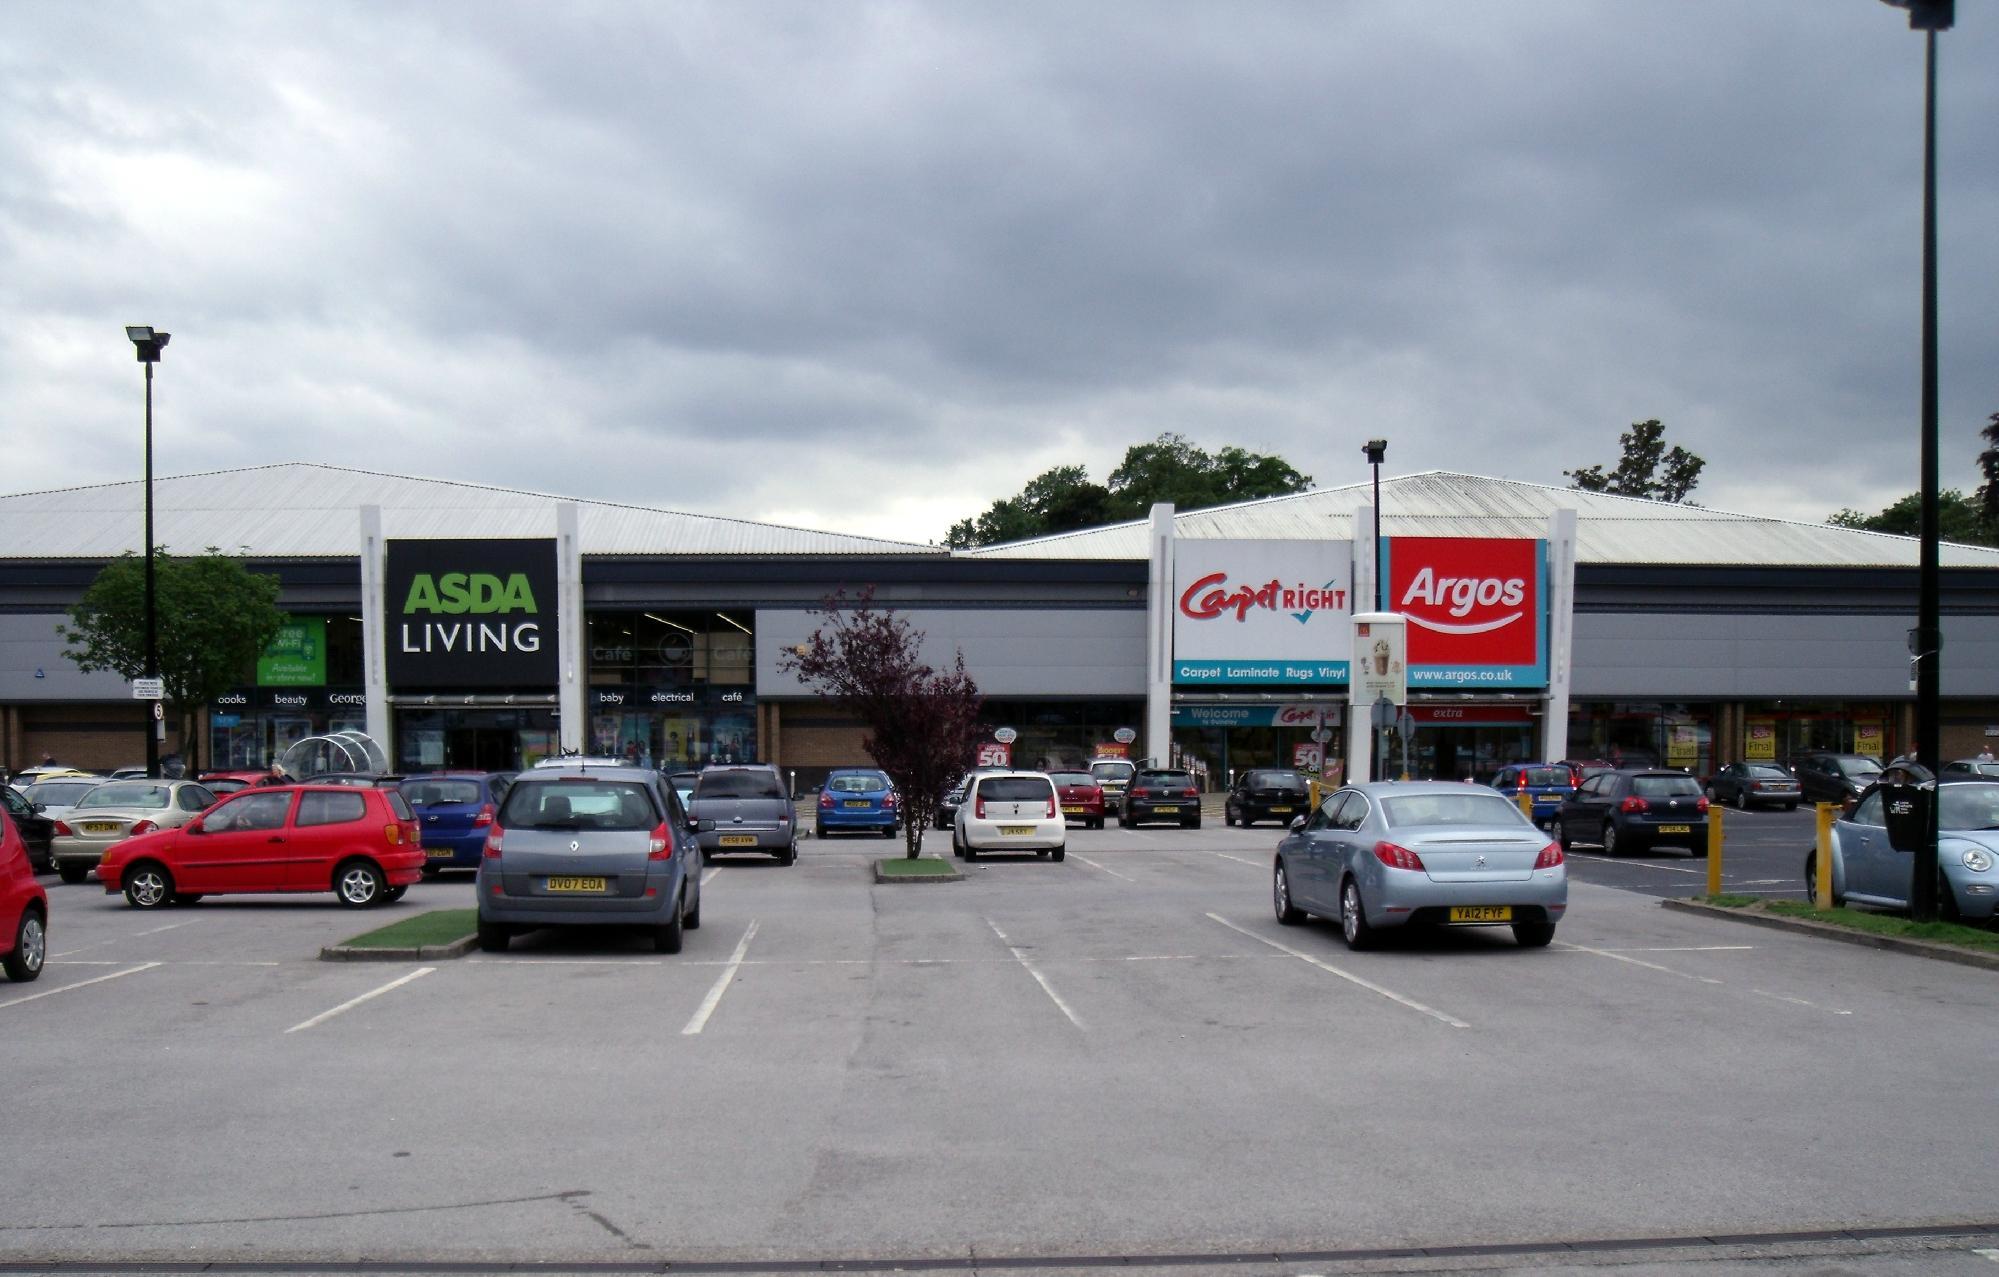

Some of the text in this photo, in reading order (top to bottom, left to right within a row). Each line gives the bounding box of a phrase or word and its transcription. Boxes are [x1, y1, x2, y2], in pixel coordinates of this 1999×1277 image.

[403, 573, 538, 614] ASDA
[1402, 568, 1525, 617] Argos
[403, 623, 540, 653] LIVING
[592, 647, 633, 661] Café
[1181, 667, 1345, 680] Carpet Laminate Rugs Vinyl
[1413, 669, 1513, 683] www.argos.co.uk
[275, 693, 308, 706] beauty
[329, 693, 367, 705] George
[600, 692, 624, 705] baby
[651, 692, 694, 702] electrical
[722, 692, 743, 702] café
[1191, 708, 1249, 719] Welcome
[1433, 708, 1464, 718] extra
[1748, 741, 1772, 752] Final
[1856, 741, 1880, 751] Final
[549, 878, 579, 889] DV07
[1456, 906, 1505, 919] YA12 FYF
